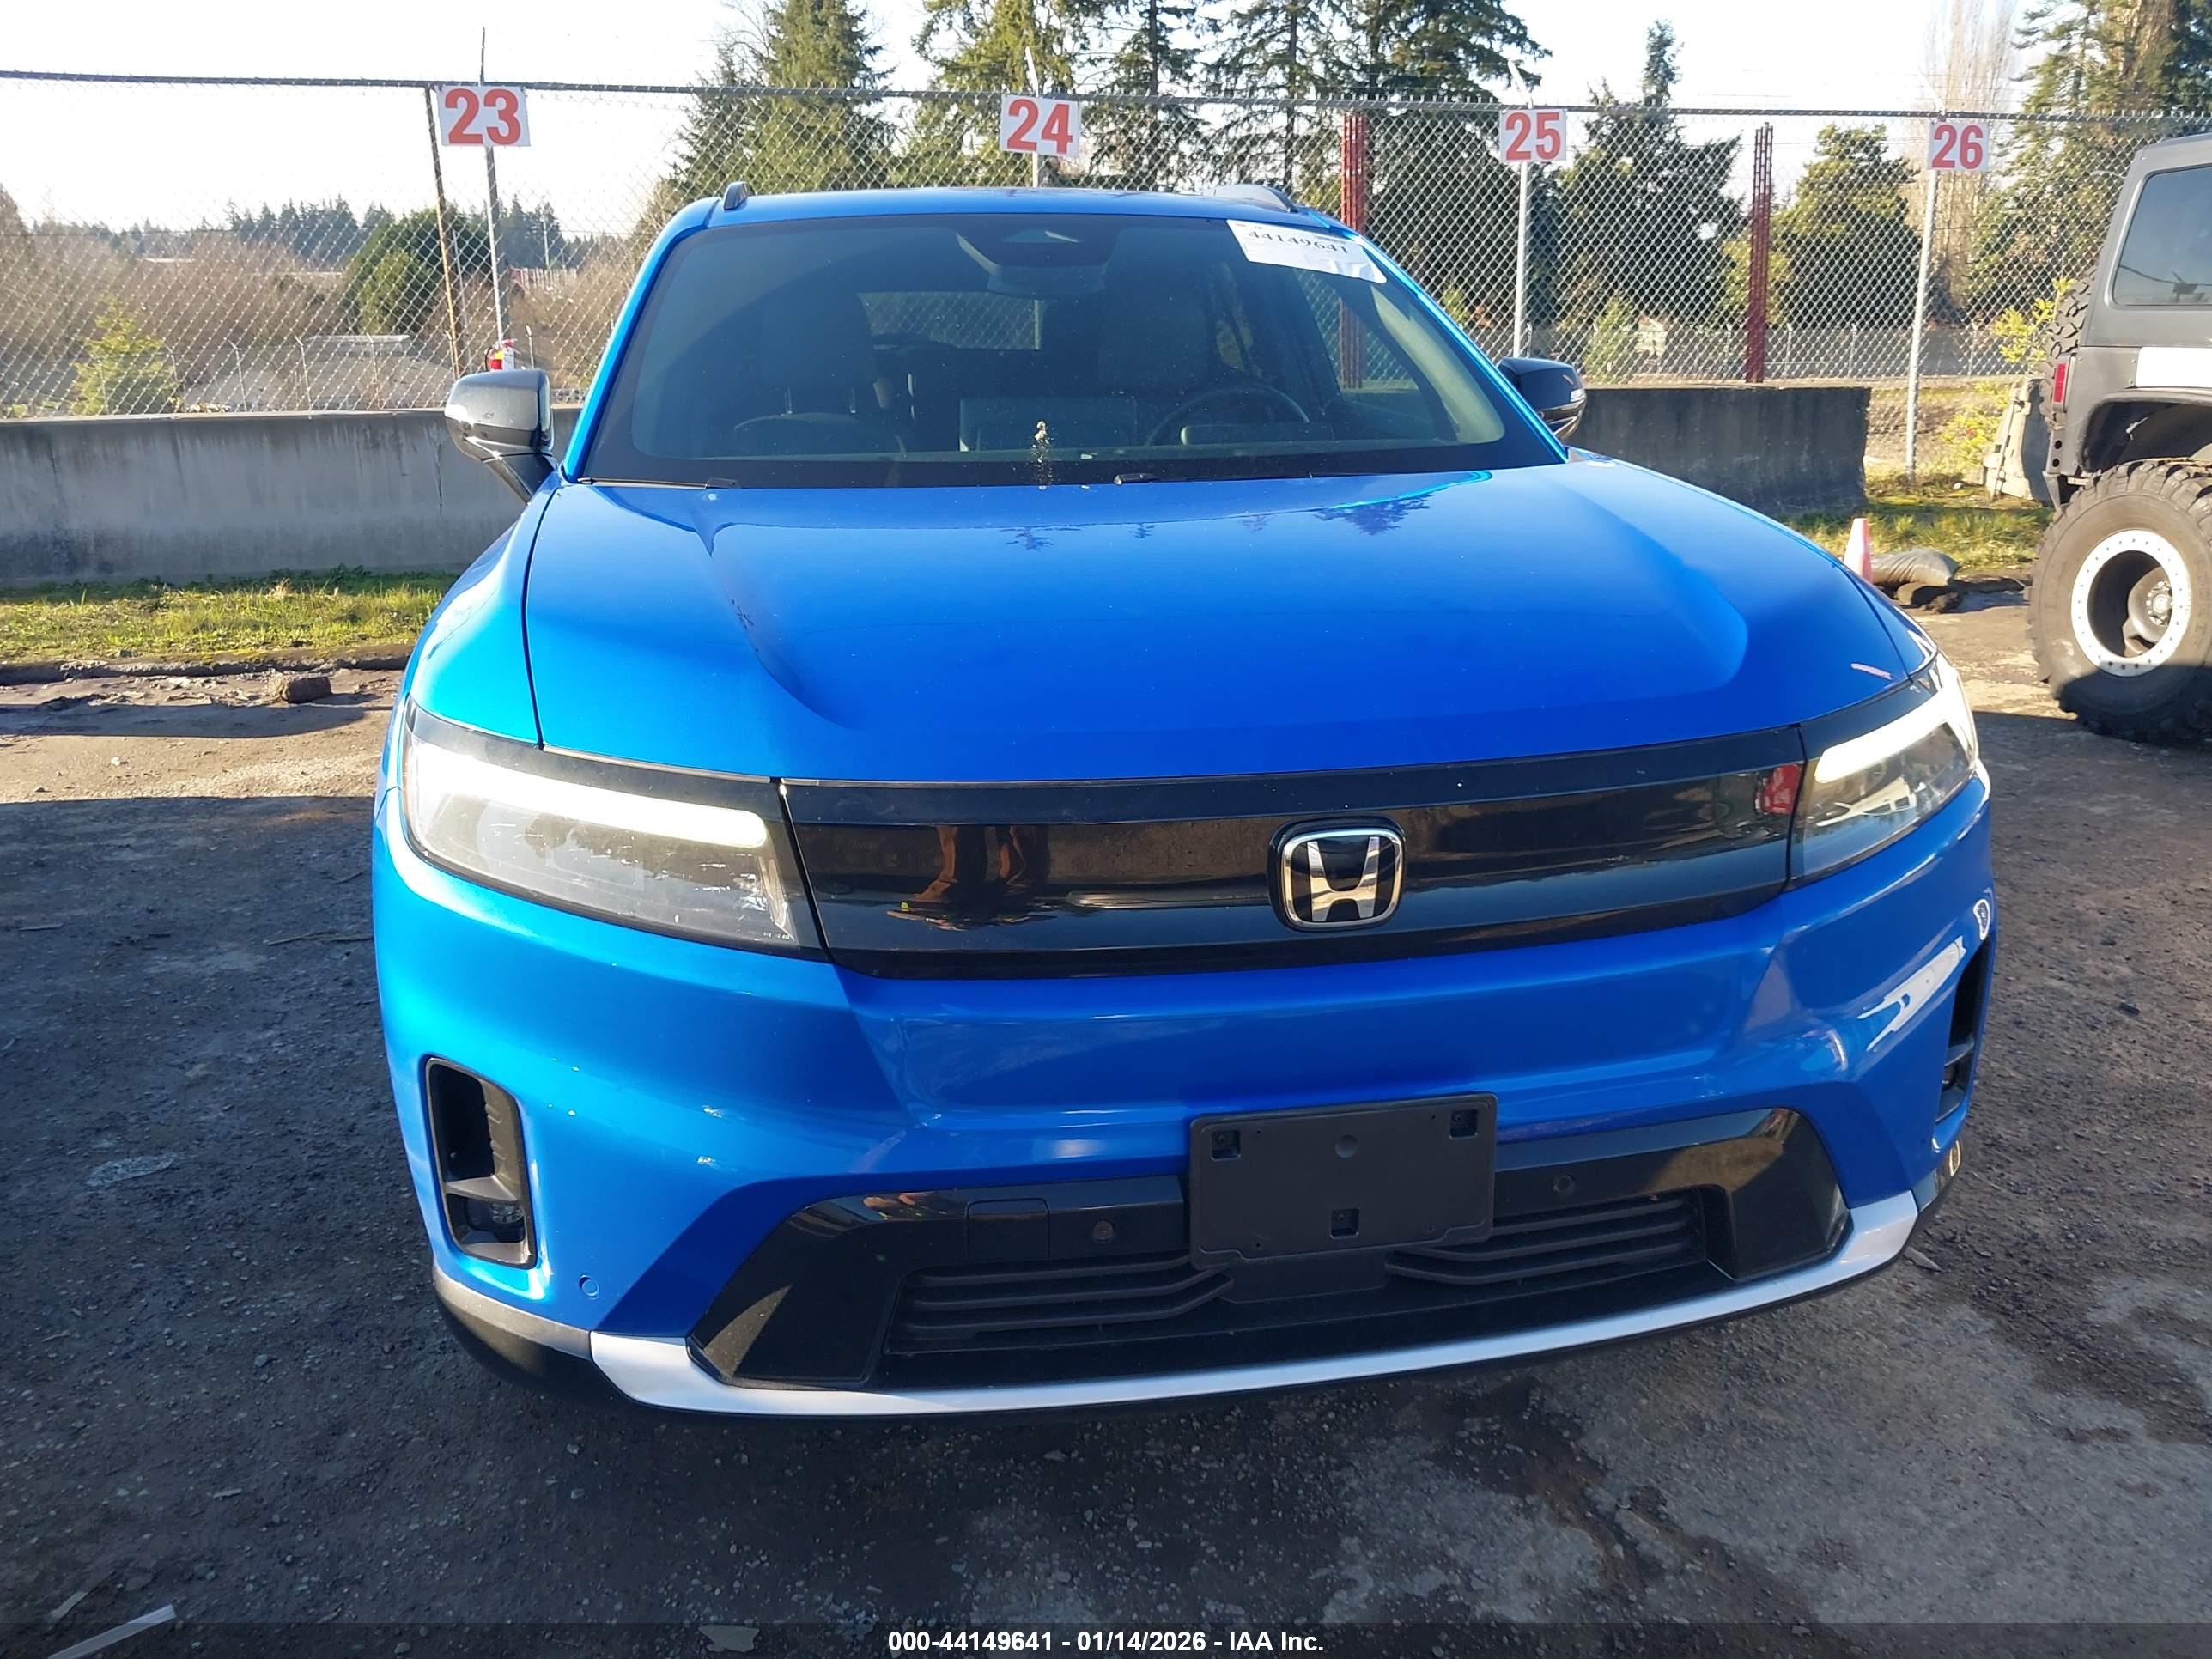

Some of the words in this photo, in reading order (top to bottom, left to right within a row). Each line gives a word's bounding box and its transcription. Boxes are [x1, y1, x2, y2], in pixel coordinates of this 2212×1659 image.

[445, 88, 521, 145] 23
[1006, 98, 1073, 155] 24
[1505, 112, 1561, 161] 25
[1931, 124, 1984, 170] 26
[1248, 230, 1349, 254] 44149641
